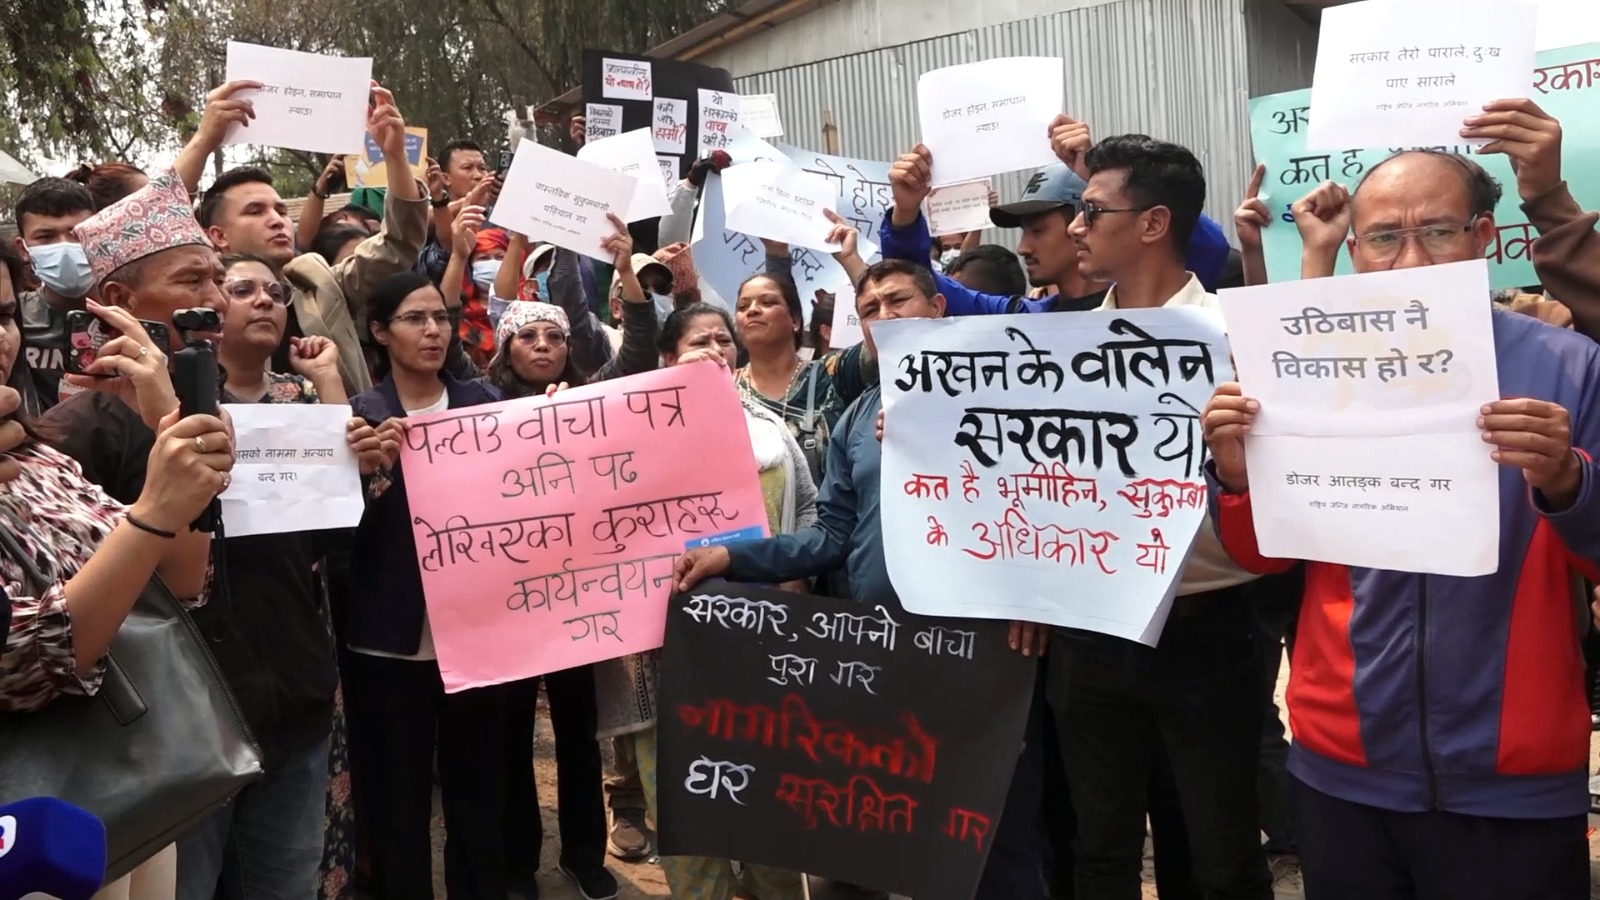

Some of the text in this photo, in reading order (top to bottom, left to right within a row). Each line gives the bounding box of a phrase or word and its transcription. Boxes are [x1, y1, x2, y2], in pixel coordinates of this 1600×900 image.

[1349, 50, 1390, 65] सरकार
[1397, 46, 1420, 61] तेरो
[1427, 43, 1469, 59] पाराले,
[309, 89, 342, 100] समाधान
[1386, 72, 1456, 89] पाए साराले
[942, 106, 963, 120] डोजर
[991, 96, 1026, 111] समाधान
[535, 181, 571, 200] वास्तविक
[543, 203, 588, 225] पहिचान गर
[1280, 299, 1430, 336] उठिबास नै
[1005, 326, 1064, 393] के
[1271, 347, 1455, 383] विकास हो र?
[516, 395, 609, 446] वाचा
[622, 385, 687, 431] पत्र
[264, 447, 297, 459] नाममा
[301, 447, 335, 459] अन्याय
[953, 406, 1140, 479] सरकार
[500, 451, 576, 499] अनि
[903, 473, 949, 501] कत
[959, 460, 981, 503] है
[1286, 470, 1321, 488] डोजर
[1430, 477, 1453, 493] गर
[959, 507, 1120, 575] अधिकार
[1134, 527, 1172, 575] यो
[562, 609, 624, 644] गर
[766, 653, 883, 696] पुरा गर
[682, 754, 991, 852] घर सुरक्षित गर
